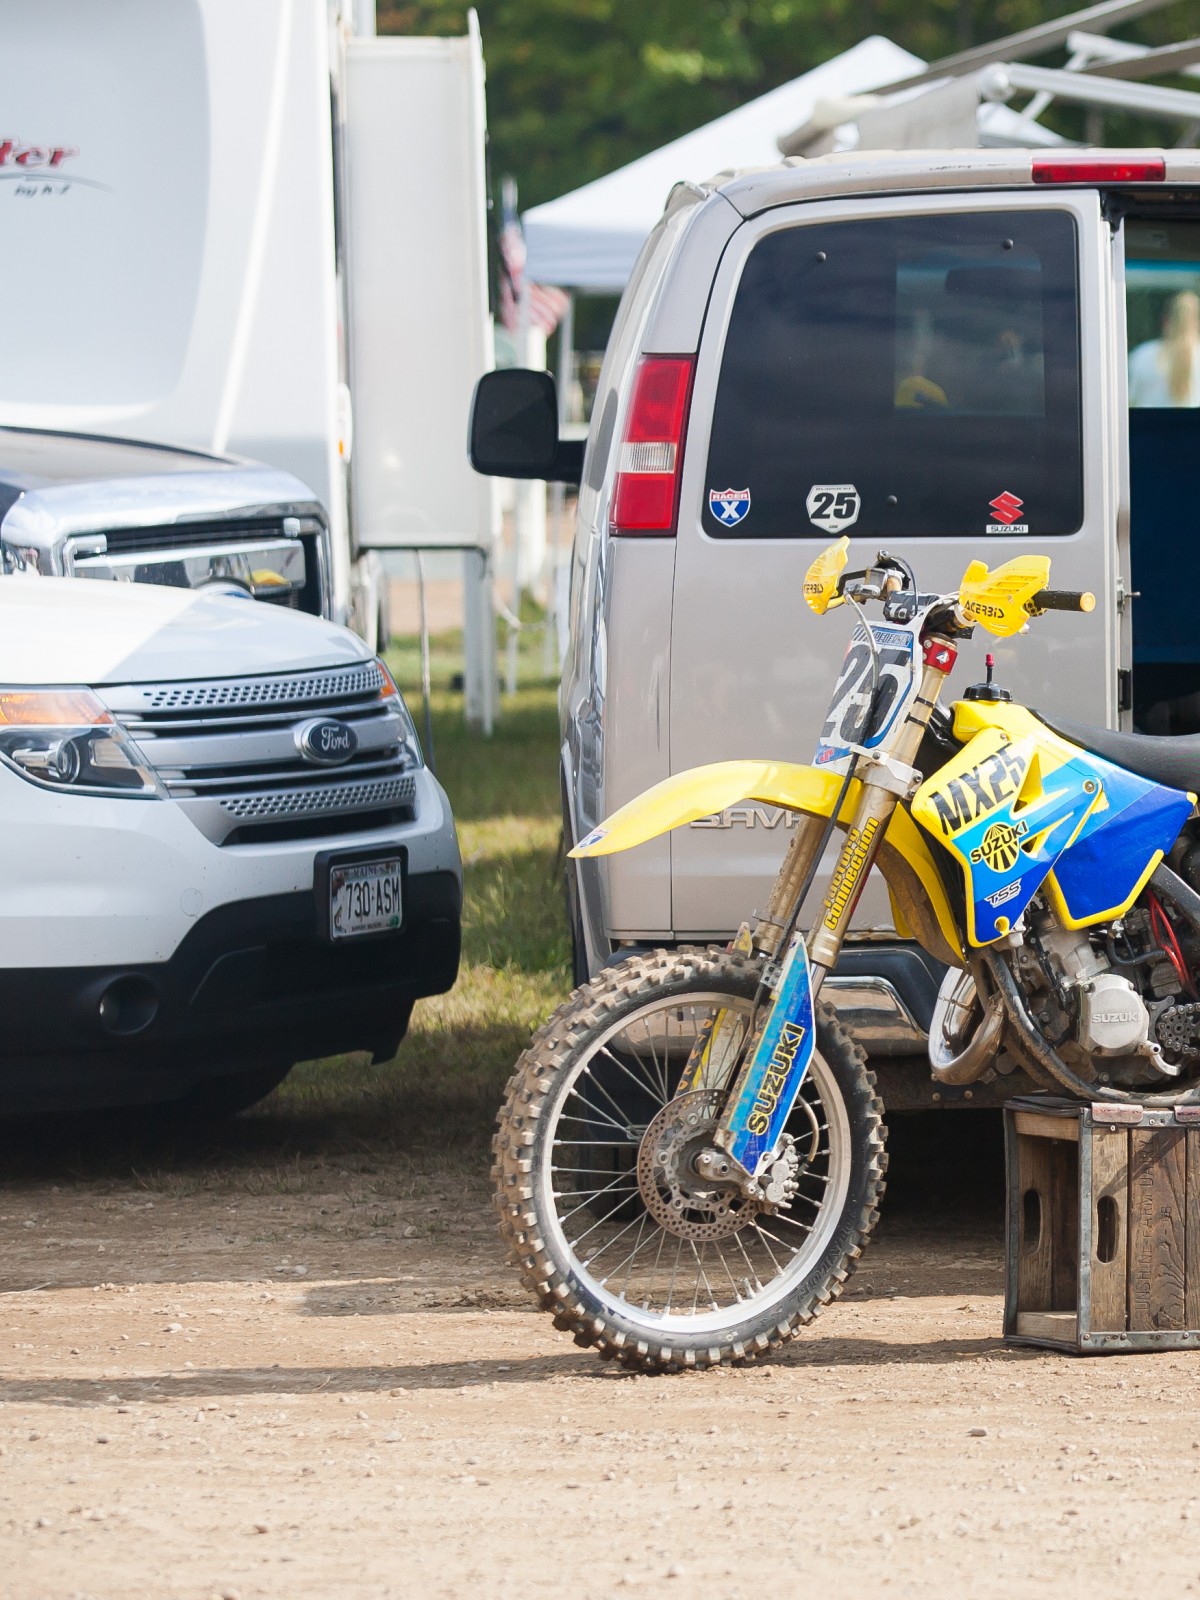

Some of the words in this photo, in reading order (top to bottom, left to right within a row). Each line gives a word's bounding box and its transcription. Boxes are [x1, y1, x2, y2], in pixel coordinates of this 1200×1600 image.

[720, 501, 740, 519] X
[811, 492, 857, 519] 25
[821, 644, 911, 744] 25
[321, 726, 350, 751] Ford
[928, 742, 1026, 836] MX25
[970, 820, 1028, 863] SUZUKI
[823, 816, 880, 931] Connection
[1091, 1011, 1140, 1024] SUZUKI
[747, 1021, 805, 1135] SUZUKI
